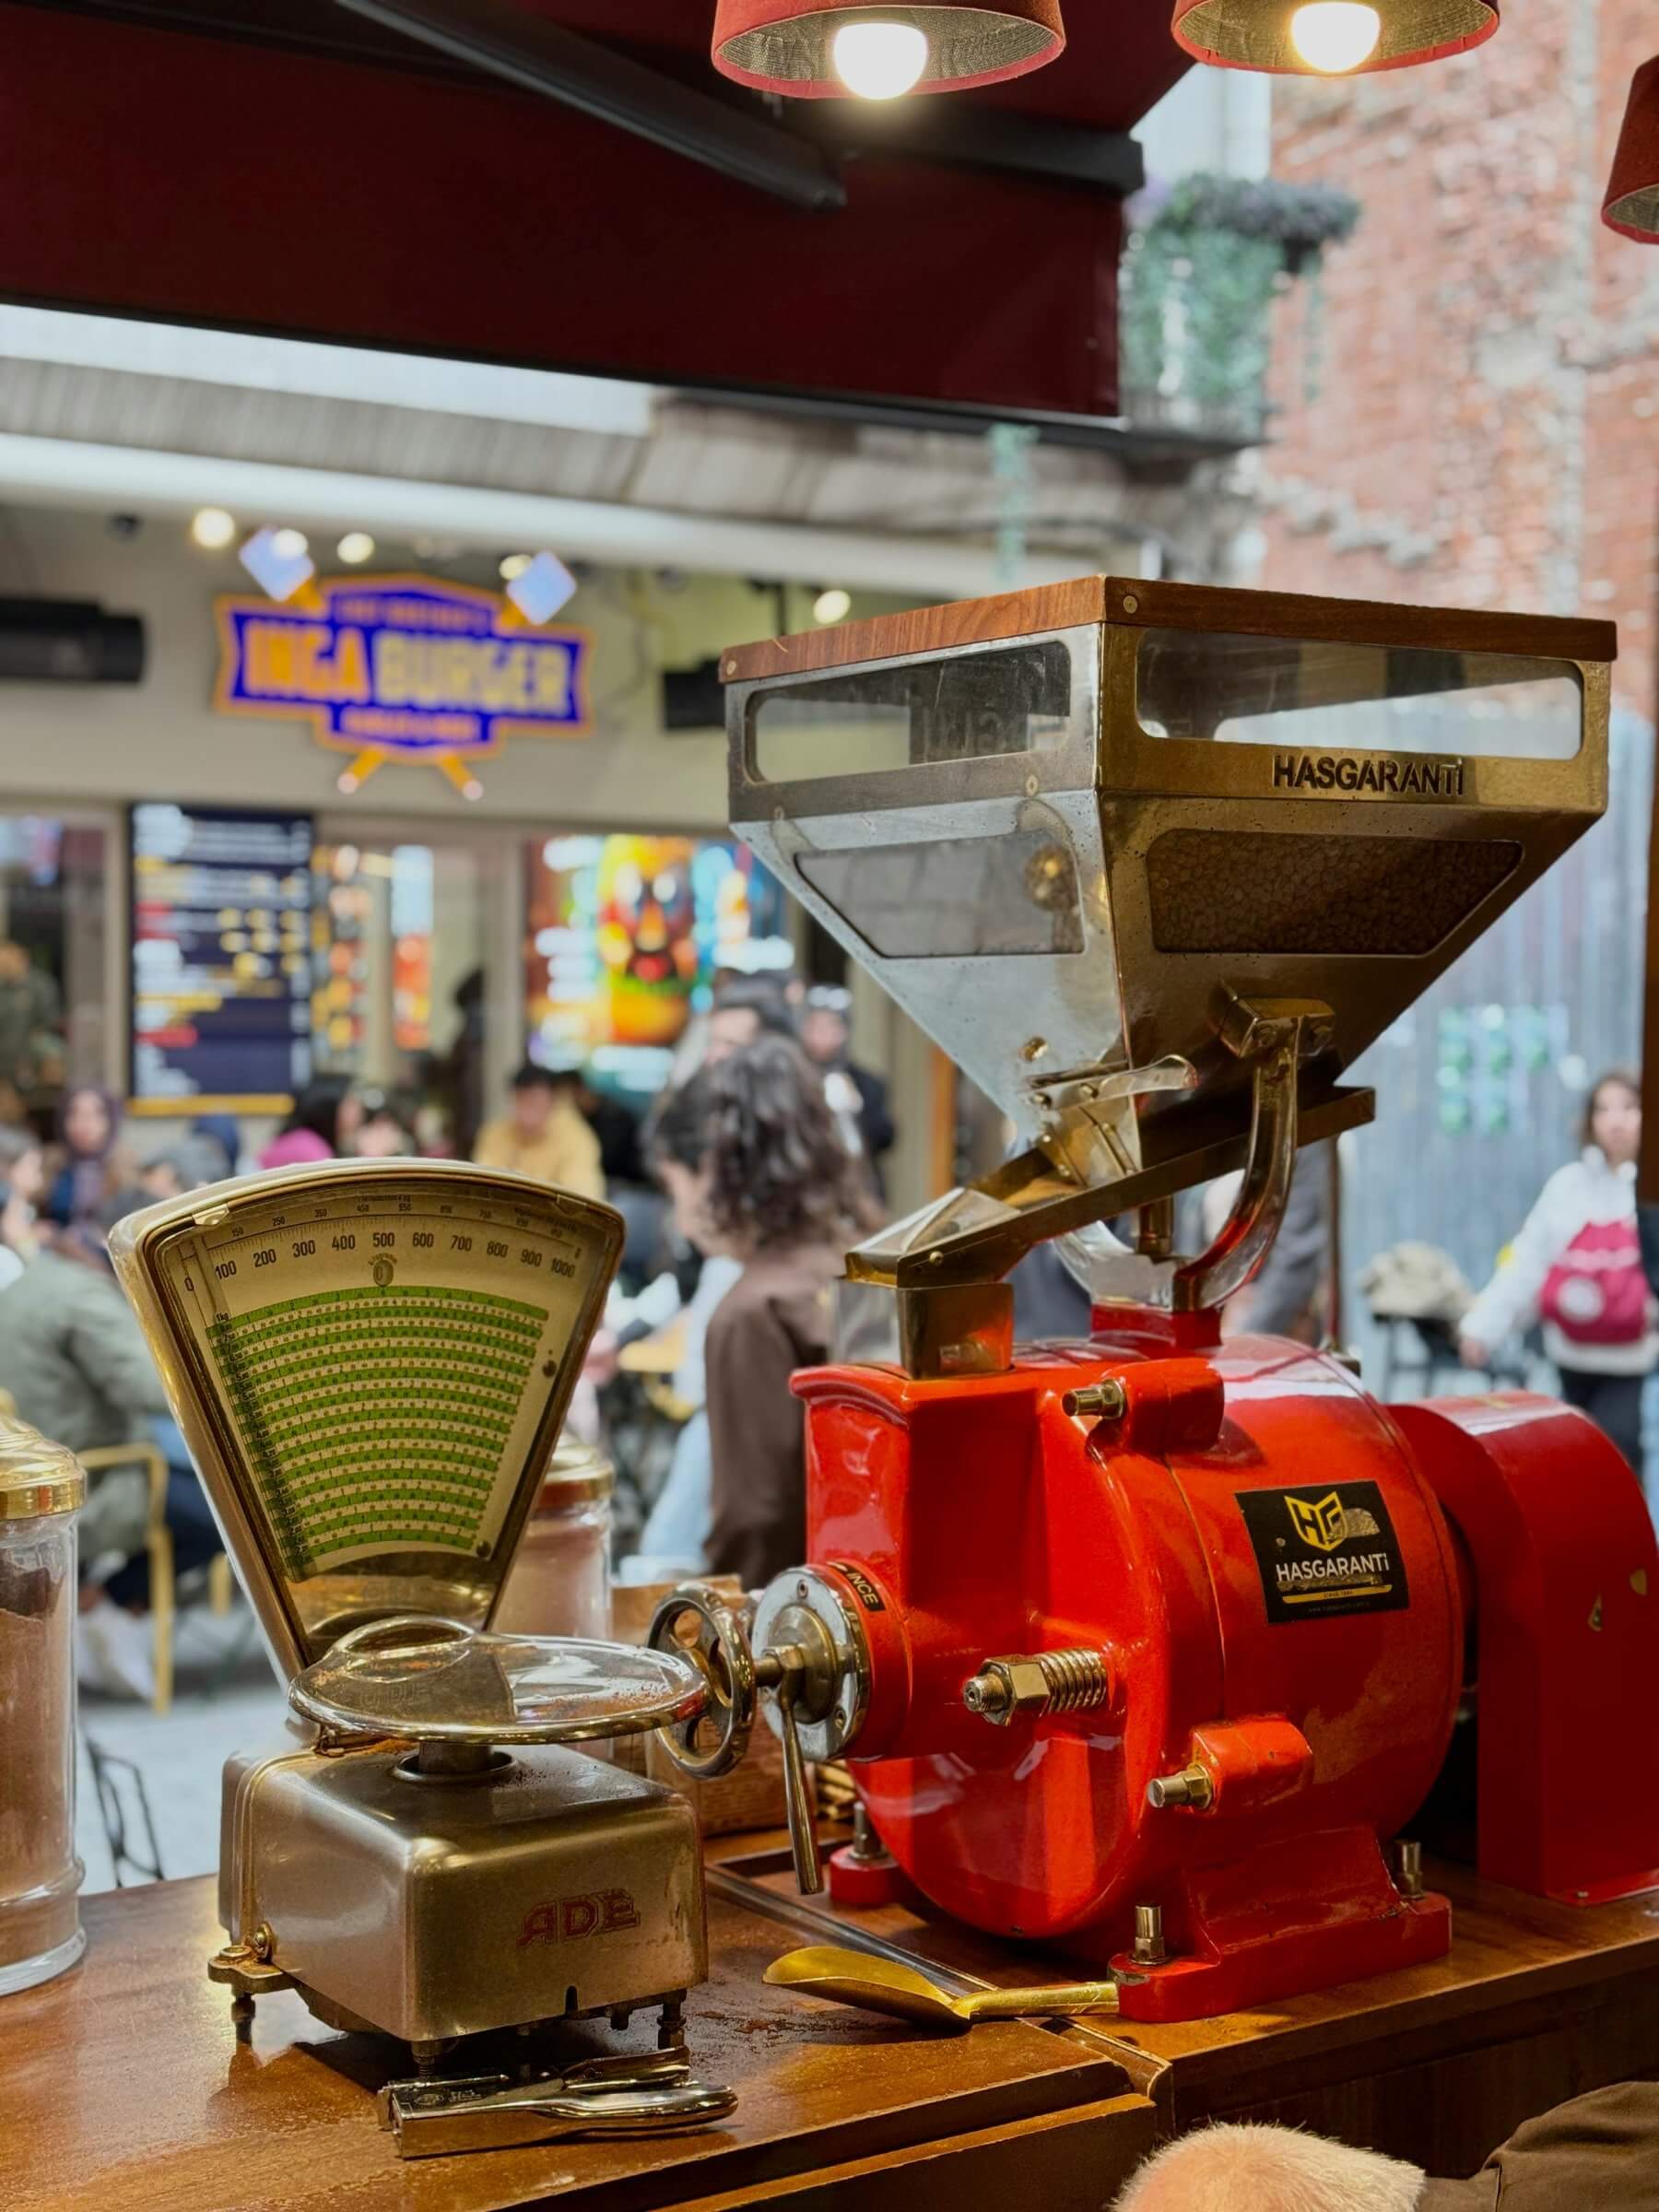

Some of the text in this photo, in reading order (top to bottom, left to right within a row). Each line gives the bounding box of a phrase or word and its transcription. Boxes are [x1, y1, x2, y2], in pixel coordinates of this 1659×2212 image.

[373, 629, 571, 716] BURGER
[272, 1216, 285, 1227] 250
[184, 1231, 576, 1292] 0 100 200 300 400 500 600 700 800 900 1000
[517, 1888, 641, 1947] ADE
